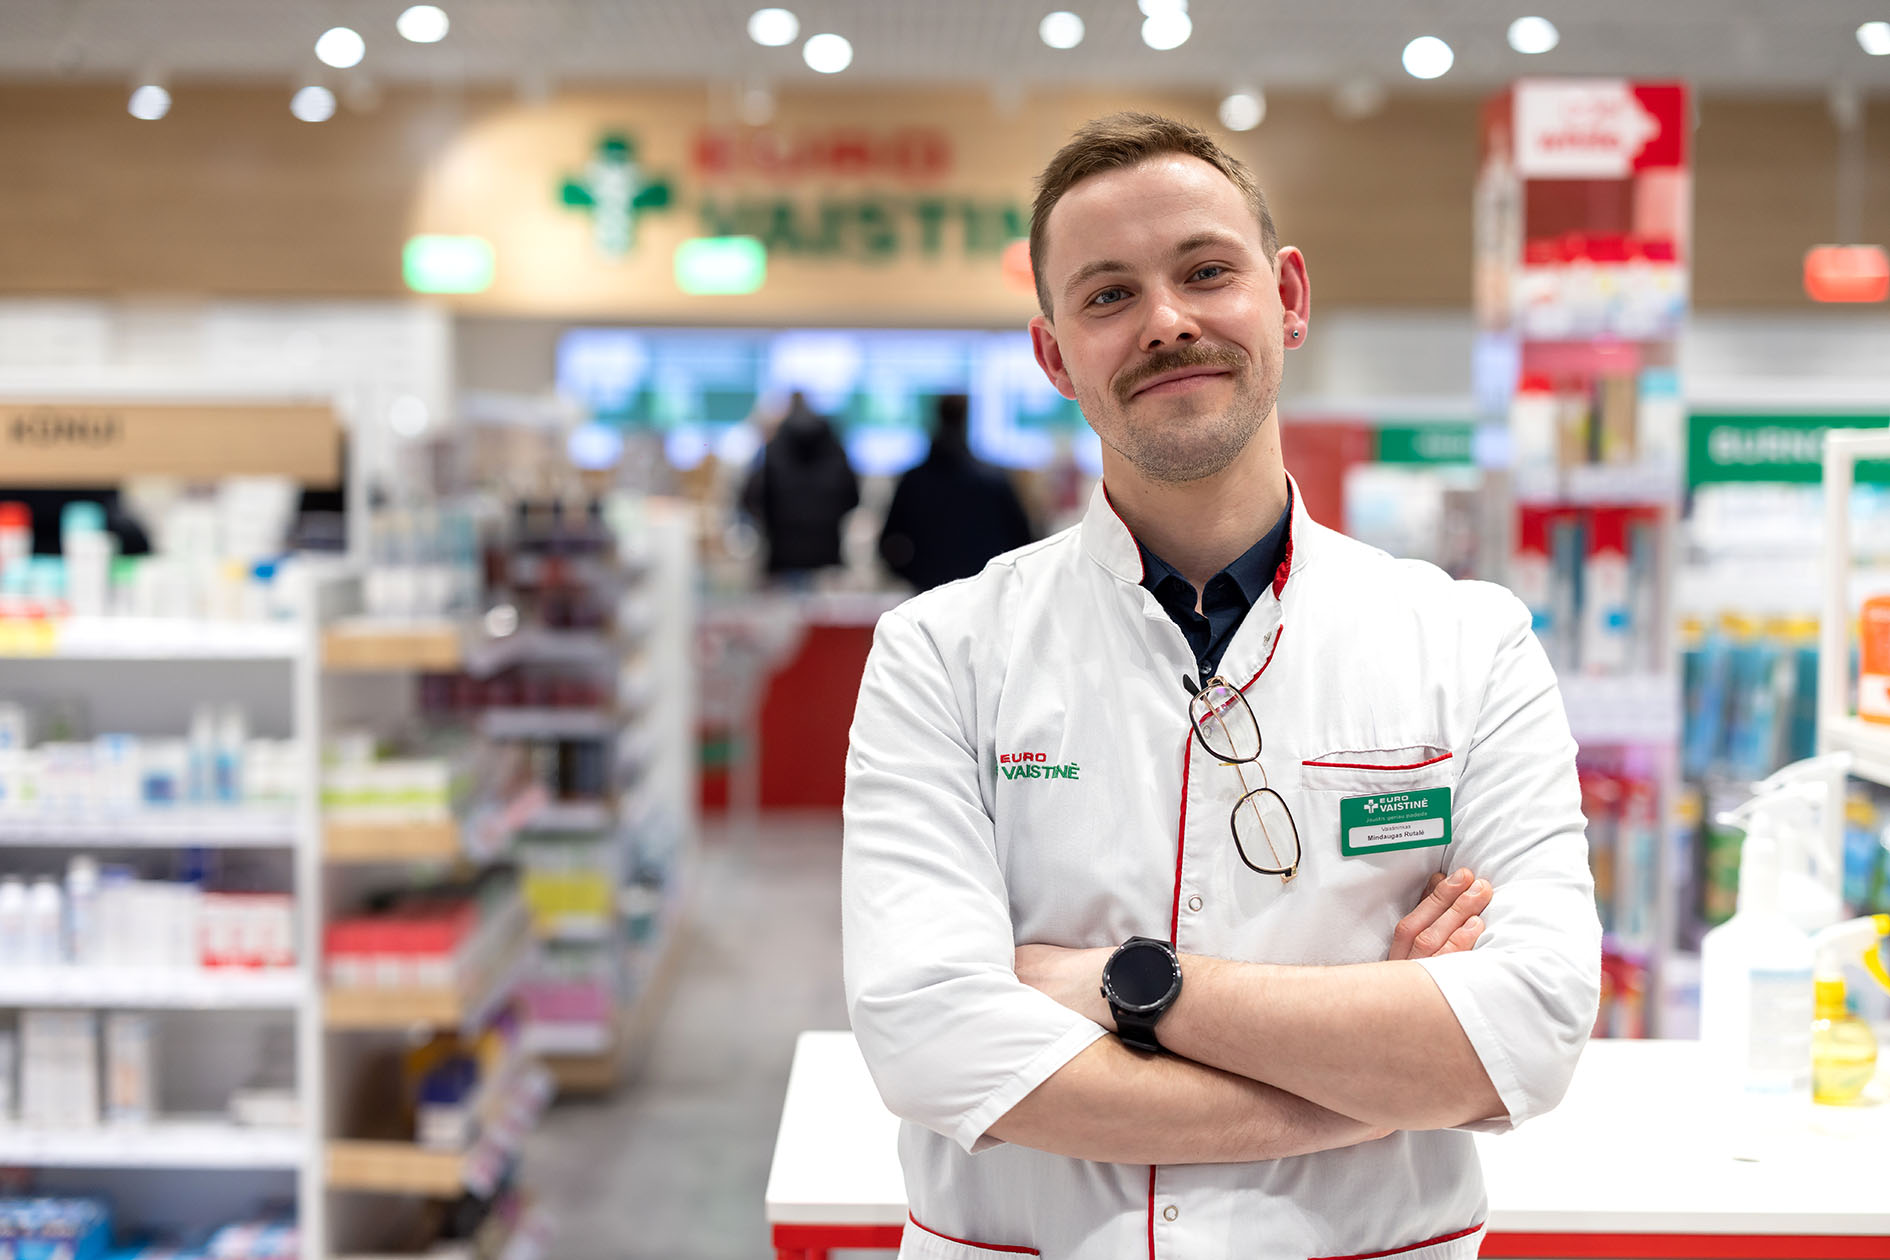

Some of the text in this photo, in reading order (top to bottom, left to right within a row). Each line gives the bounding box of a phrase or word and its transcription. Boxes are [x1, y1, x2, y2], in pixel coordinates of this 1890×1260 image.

[690, 126, 954, 188] EURO
[1000, 752, 1047, 763] EURO
[1001, 762, 1080, 780] VAISTINĖ
[1379, 795, 1409, 804] EURO
[1379, 798, 1429, 812] VAISTINĖ
[1367, 832, 1403, 841] Mindaugas
